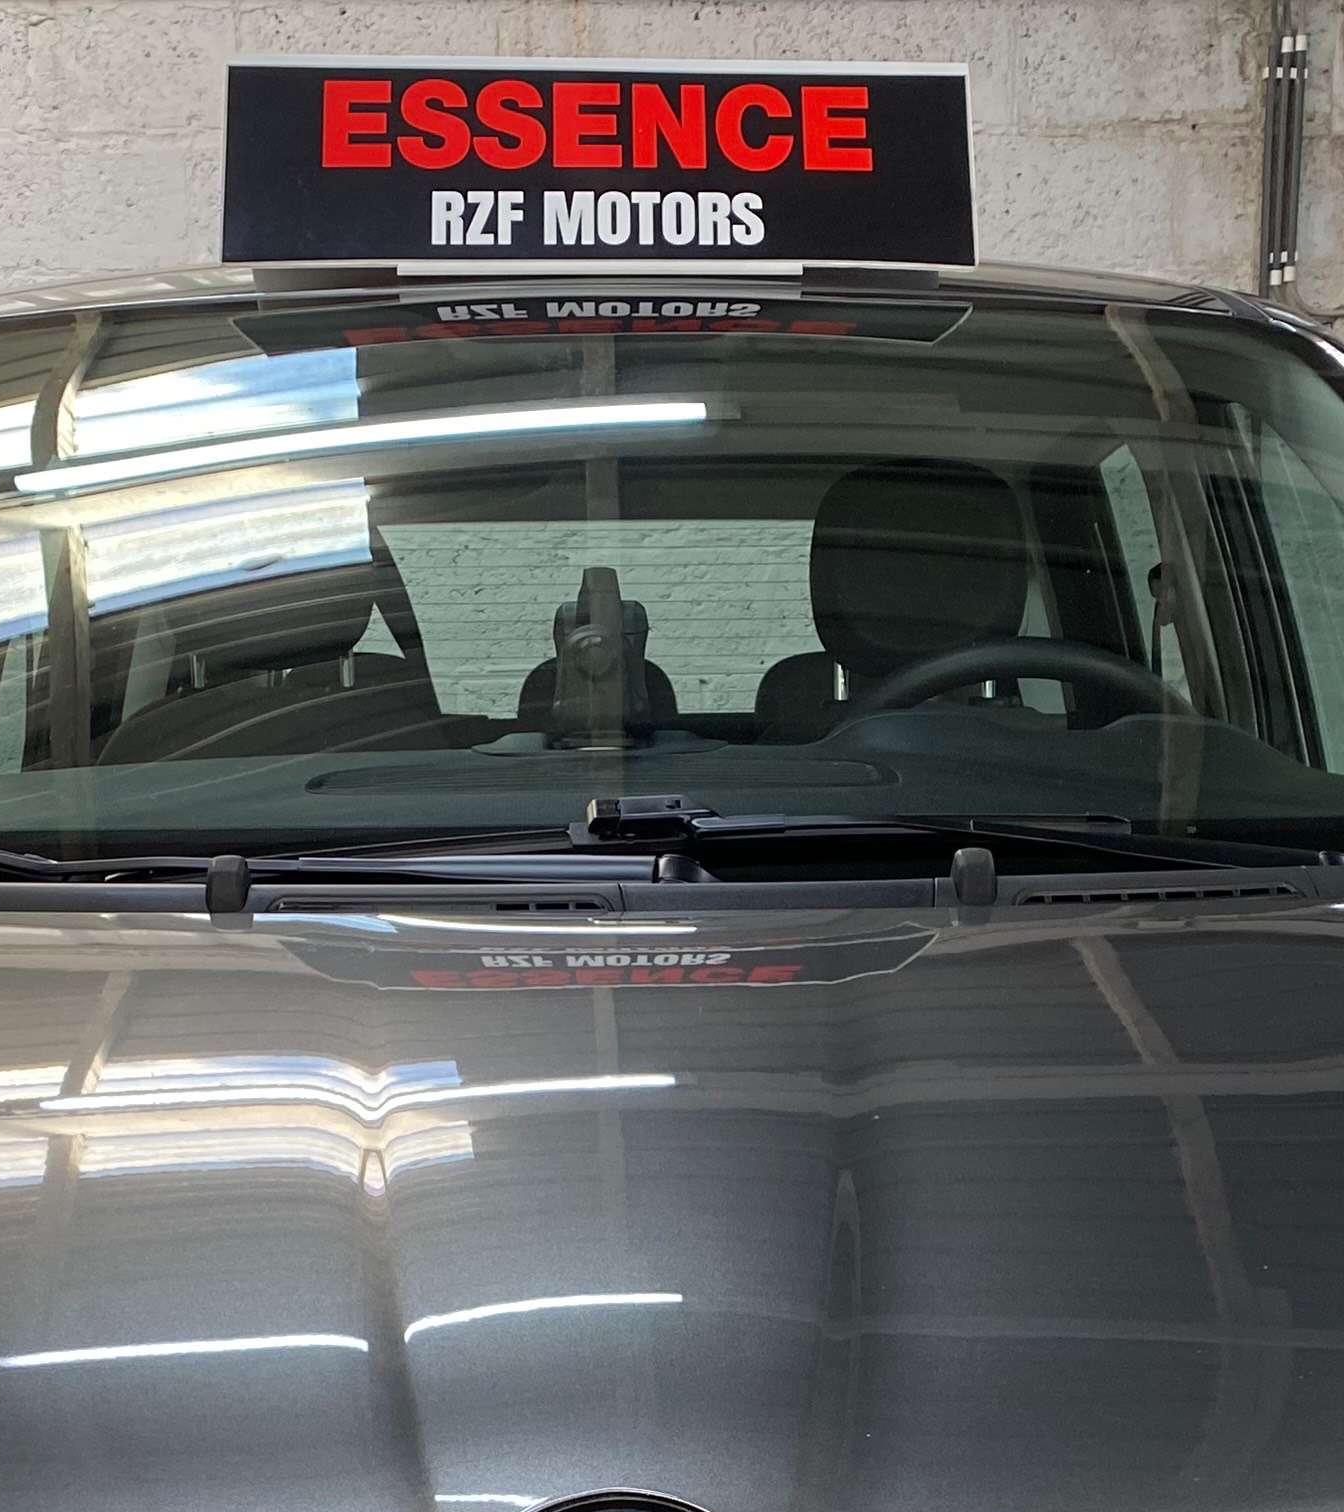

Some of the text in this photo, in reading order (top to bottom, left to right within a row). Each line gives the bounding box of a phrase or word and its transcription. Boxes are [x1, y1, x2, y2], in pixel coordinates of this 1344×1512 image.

[321, 79, 874, 171] ESSENCE
[431, 190, 765, 246] RZF MOTORS
